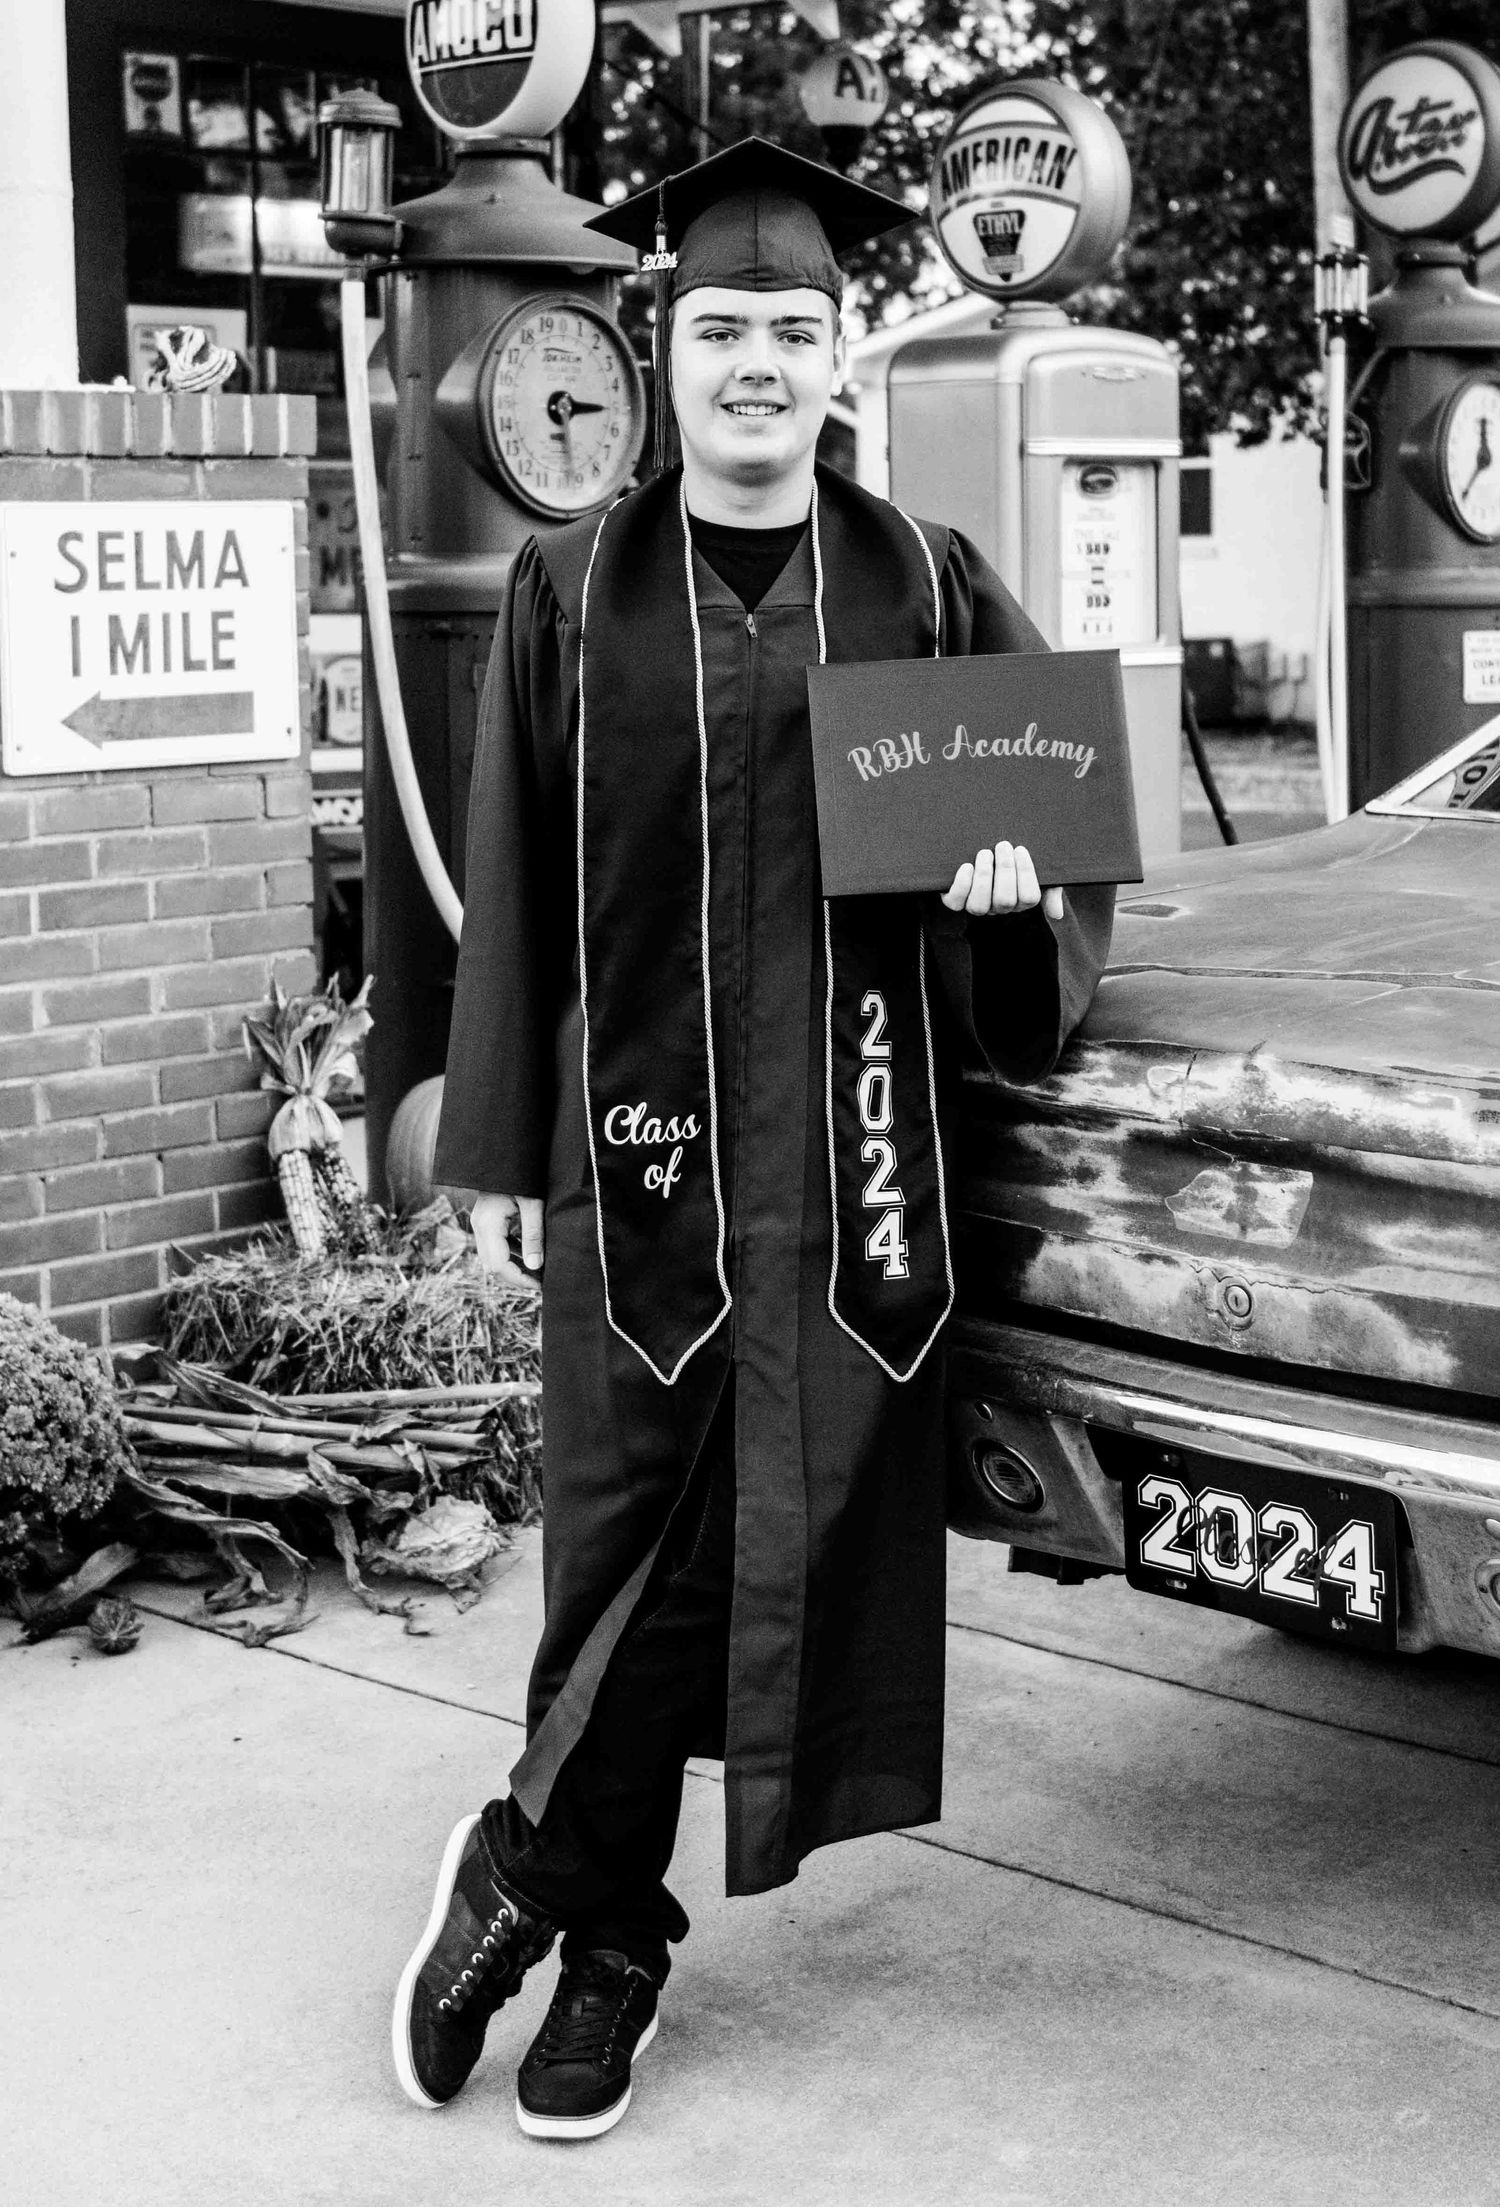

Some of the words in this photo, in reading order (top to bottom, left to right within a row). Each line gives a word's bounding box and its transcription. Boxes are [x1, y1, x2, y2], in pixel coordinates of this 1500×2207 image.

[411, 0, 534, 63] AMOCO
[941, 136, 1078, 200] AMERICAN
[977, 212, 1020, 236] ETHYL
[640, 251, 678, 272] 2024
[539, 316, 554, 333] 19
[577, 321, 584, 338] 1
[520, 328, 535, 345] 18
[592, 333, 601, 350] 2
[507, 348, 520, 365] 17
[605, 356, 614, 372] 3
[611, 376, 620, 393] 4
[499, 415, 512, 432] 14
[610, 421, 620, 438] 6
[604, 443, 611, 461] 7
[518, 459, 533, 476] 12
[592, 460, 600, 479] 8
[536, 470, 549, 488] 11
[574, 472, 585, 489] 9
[54, 530, 250, 593] SELMA
[108, 610, 236, 676] MILE
[848, 731, 931, 781] RBH
[942, 722, 1098, 779] Academy
[604, 1101, 702, 1145] Class
[856, 989, 910, 1280] 2024
[643, 1146, 684, 1199] of
[1138, 1474, 1386, 1622] 2024
